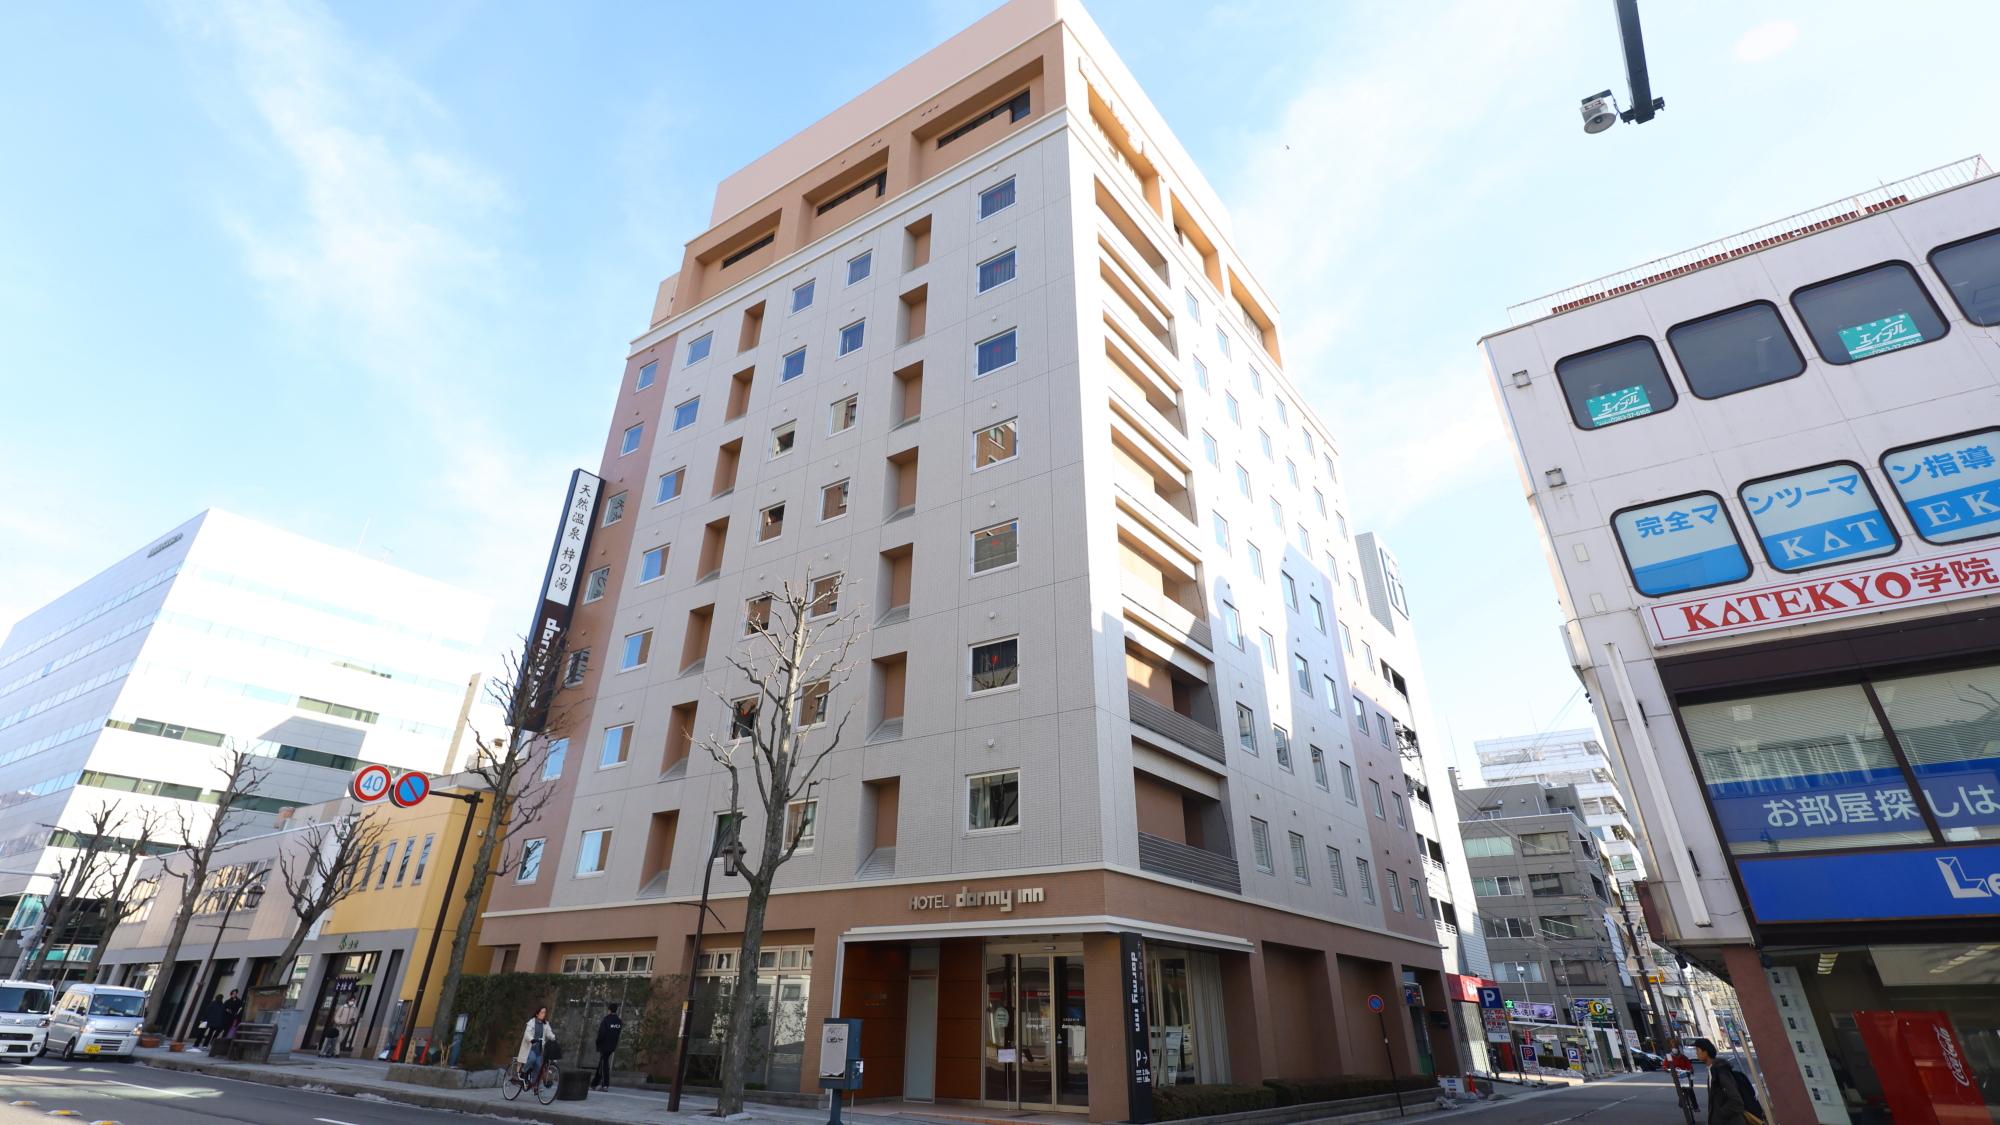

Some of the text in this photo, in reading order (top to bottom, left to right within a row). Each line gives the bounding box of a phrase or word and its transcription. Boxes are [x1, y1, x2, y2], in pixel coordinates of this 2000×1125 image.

[1858, 319, 1907, 345] エイブル
[1601, 391, 1641, 413] エイブル
[1635, 445, 1997, 539] 完全マ ンツーマ ン指導
[554, 484, 592, 592] 天然温泉 梓の湯
[1777, 518, 1880, 562] KAT
[1680, 556, 2000, 632] KATEKYO学院
[362, 775, 384, 792] 40
[1763, 784, 2000, 827] お部屋探しは
[908, 886, 1045, 912] HOTEL dormy inn
[1130, 951, 1140, 1004] dormy
[1483, 989, 1496, 1007] P
[1595, 1003, 1603, 1013] P
[1135, 1049, 1142, 1067] P
[1523, 1047, 1534, 1060] P
[1569, 1050, 1577, 1059] P
